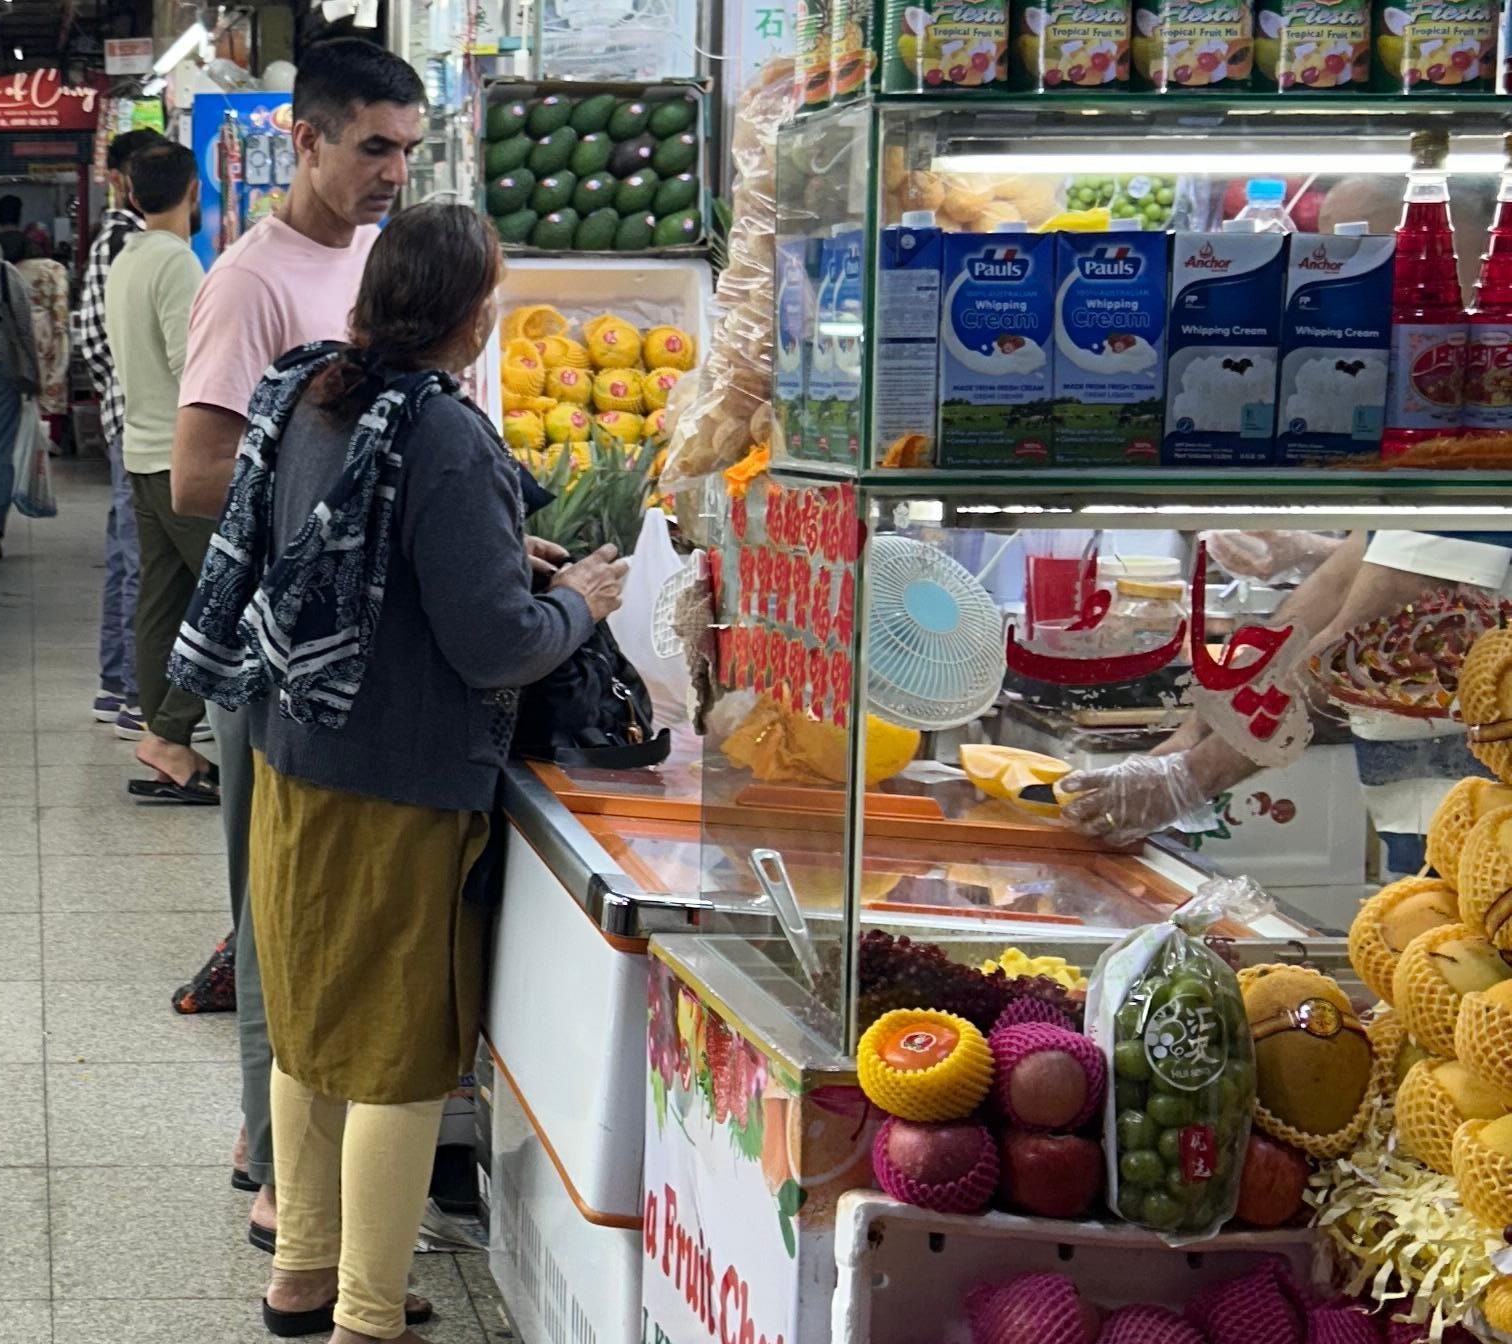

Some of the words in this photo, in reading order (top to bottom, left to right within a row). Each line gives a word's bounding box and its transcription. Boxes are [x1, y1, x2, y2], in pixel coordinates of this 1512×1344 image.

[5, 72, 28, 102] of
[974, 262, 1022, 276] Pauls
[1085, 261, 1134, 275] Pauls
[1184, 256, 1232, 270] Anchor
[1299, 257, 1345, 271] Anchor
[975, 299, 1027, 312] Whipping
[1086, 299, 1138, 311] Whipping
[961, 309, 1038, 329] Cream
[1072, 307, 1150, 329] Cream
[1181, 325, 1230, 337] Whipping
[1233, 326, 1267, 336] Cream
[1295, 326, 1343, 338] Whipping
[1345, 328, 1379, 338] Cream
[661, 1182, 716, 1336] Fruit
